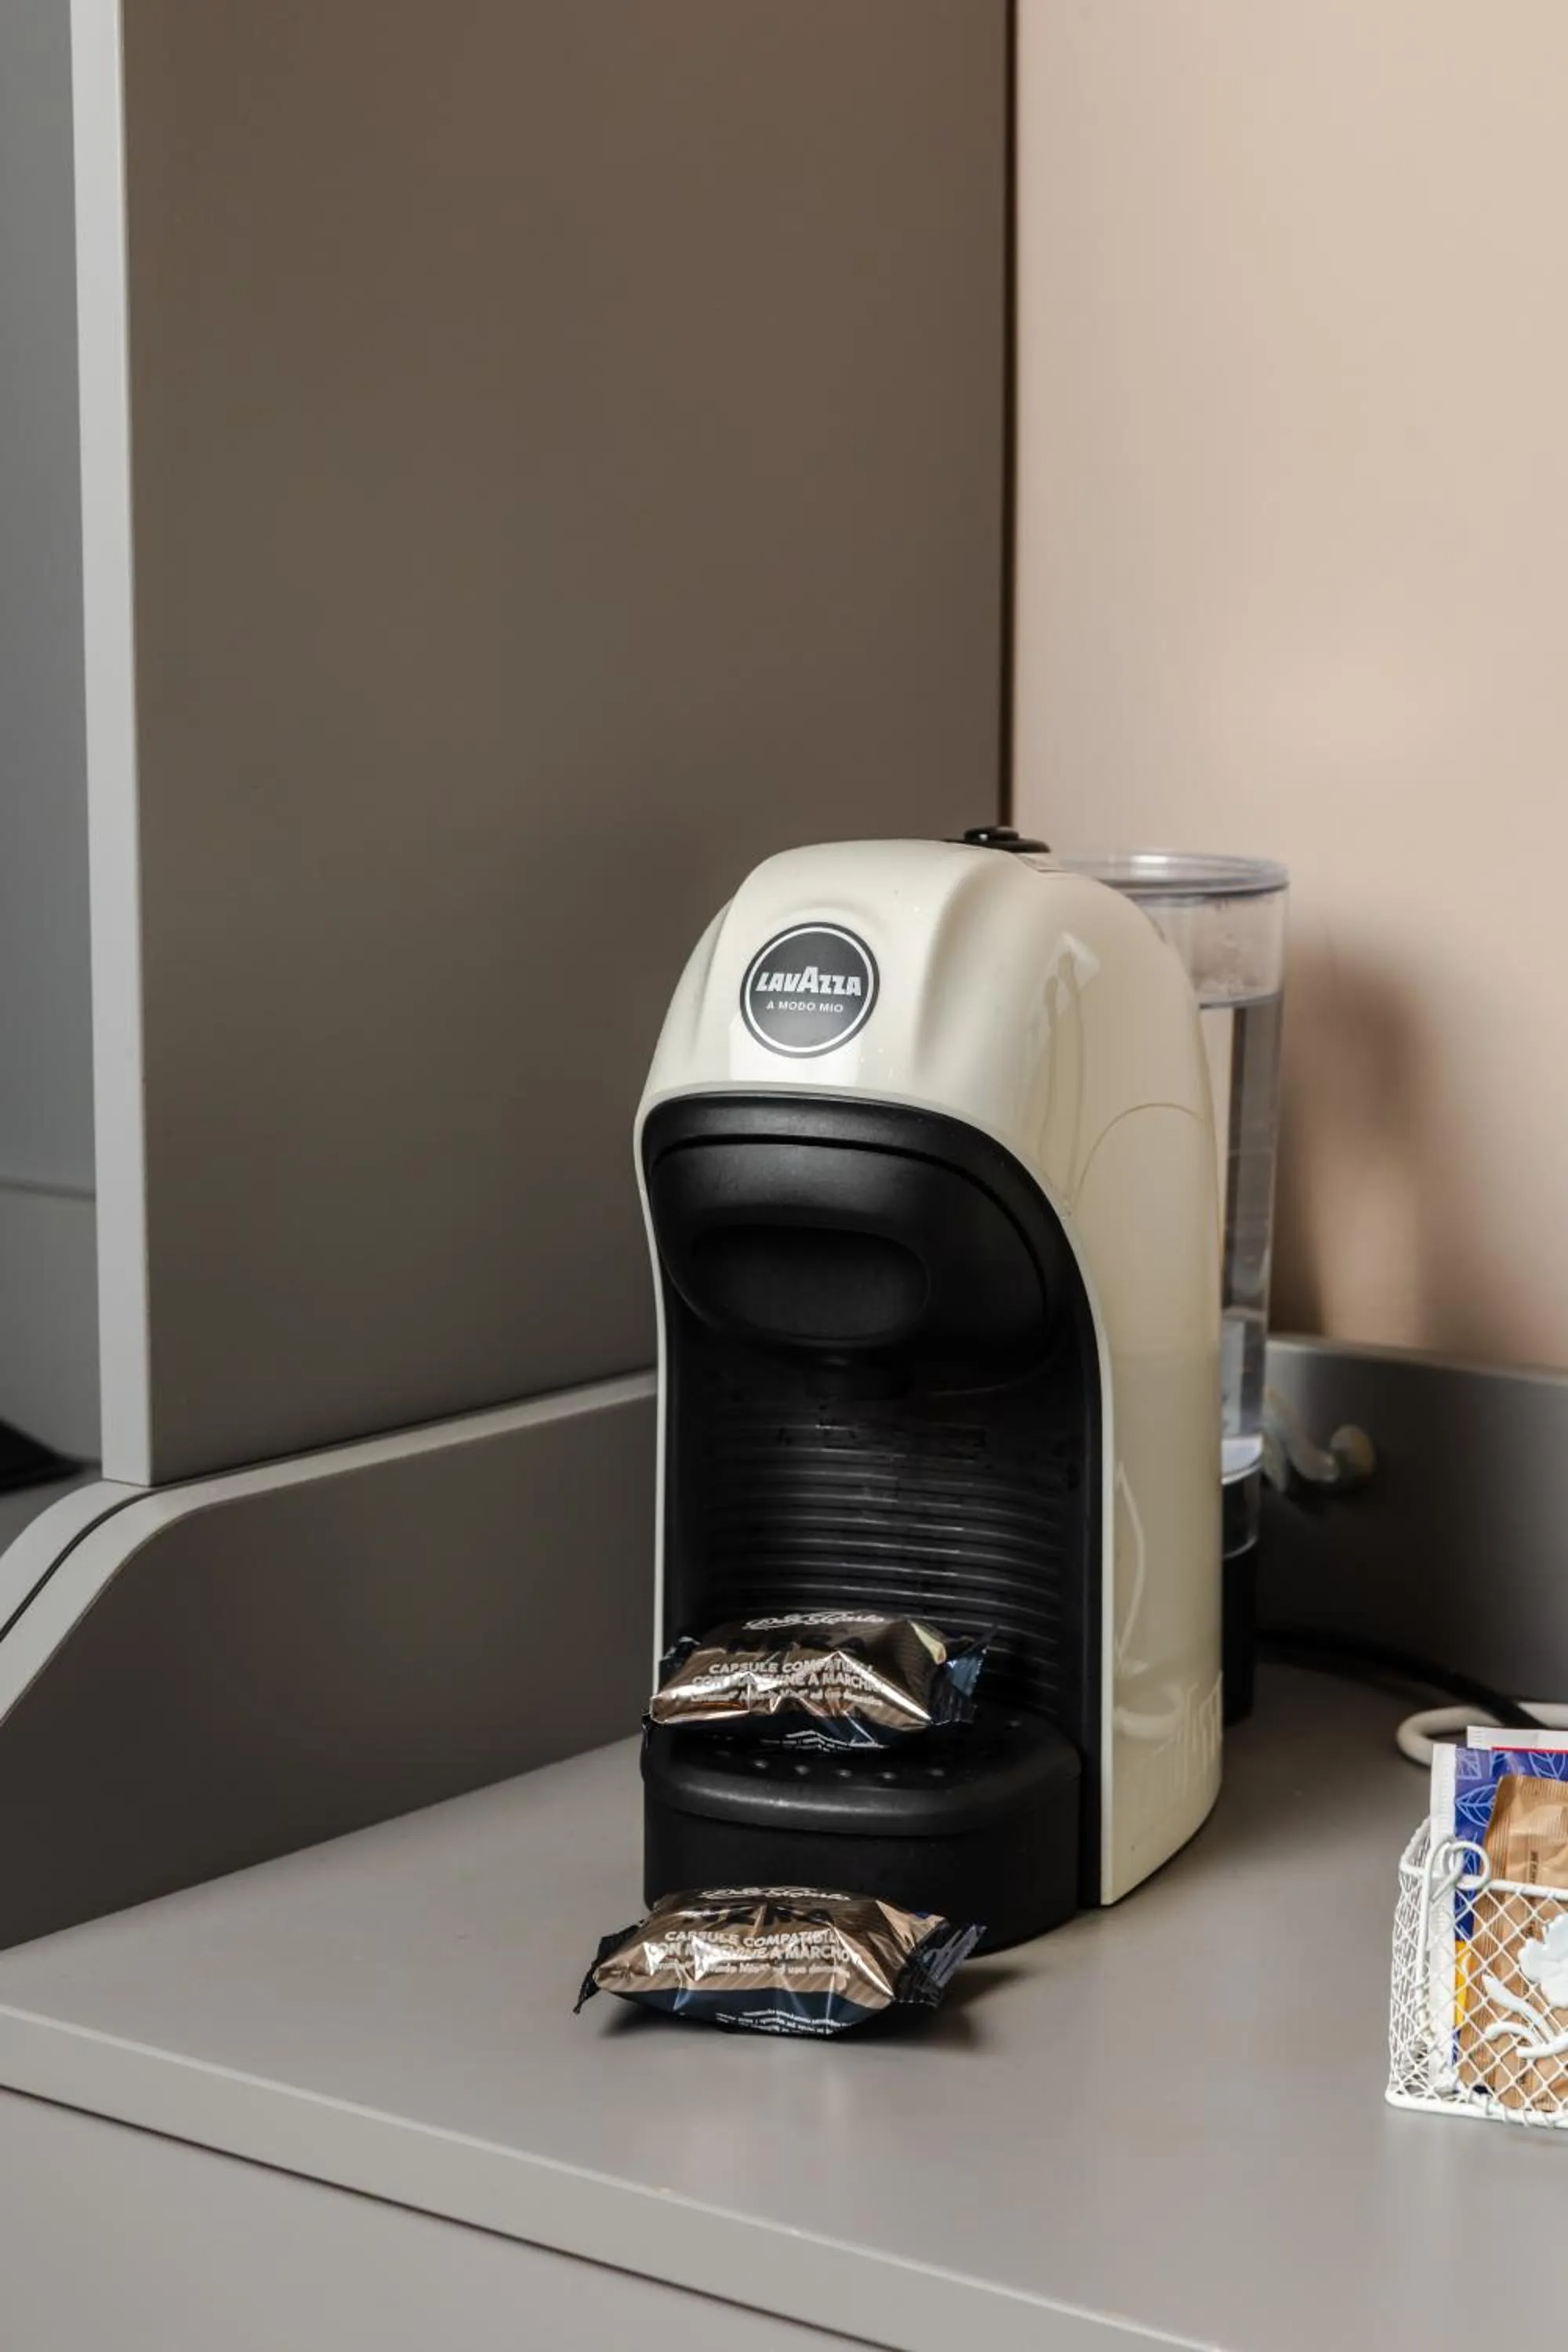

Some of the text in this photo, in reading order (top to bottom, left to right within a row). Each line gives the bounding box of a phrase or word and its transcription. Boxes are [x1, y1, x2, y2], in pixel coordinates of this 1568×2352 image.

[756, 966, 862, 996] LAVAZZA
[766, 1000, 844, 1012] A MODO MIO
[708, 1661, 779, 1674] CAPSULE
[808, 1671, 819, 1686] A
[665, 1931, 740, 1944] CAPSULE
[771, 1946, 782, 1958] A
